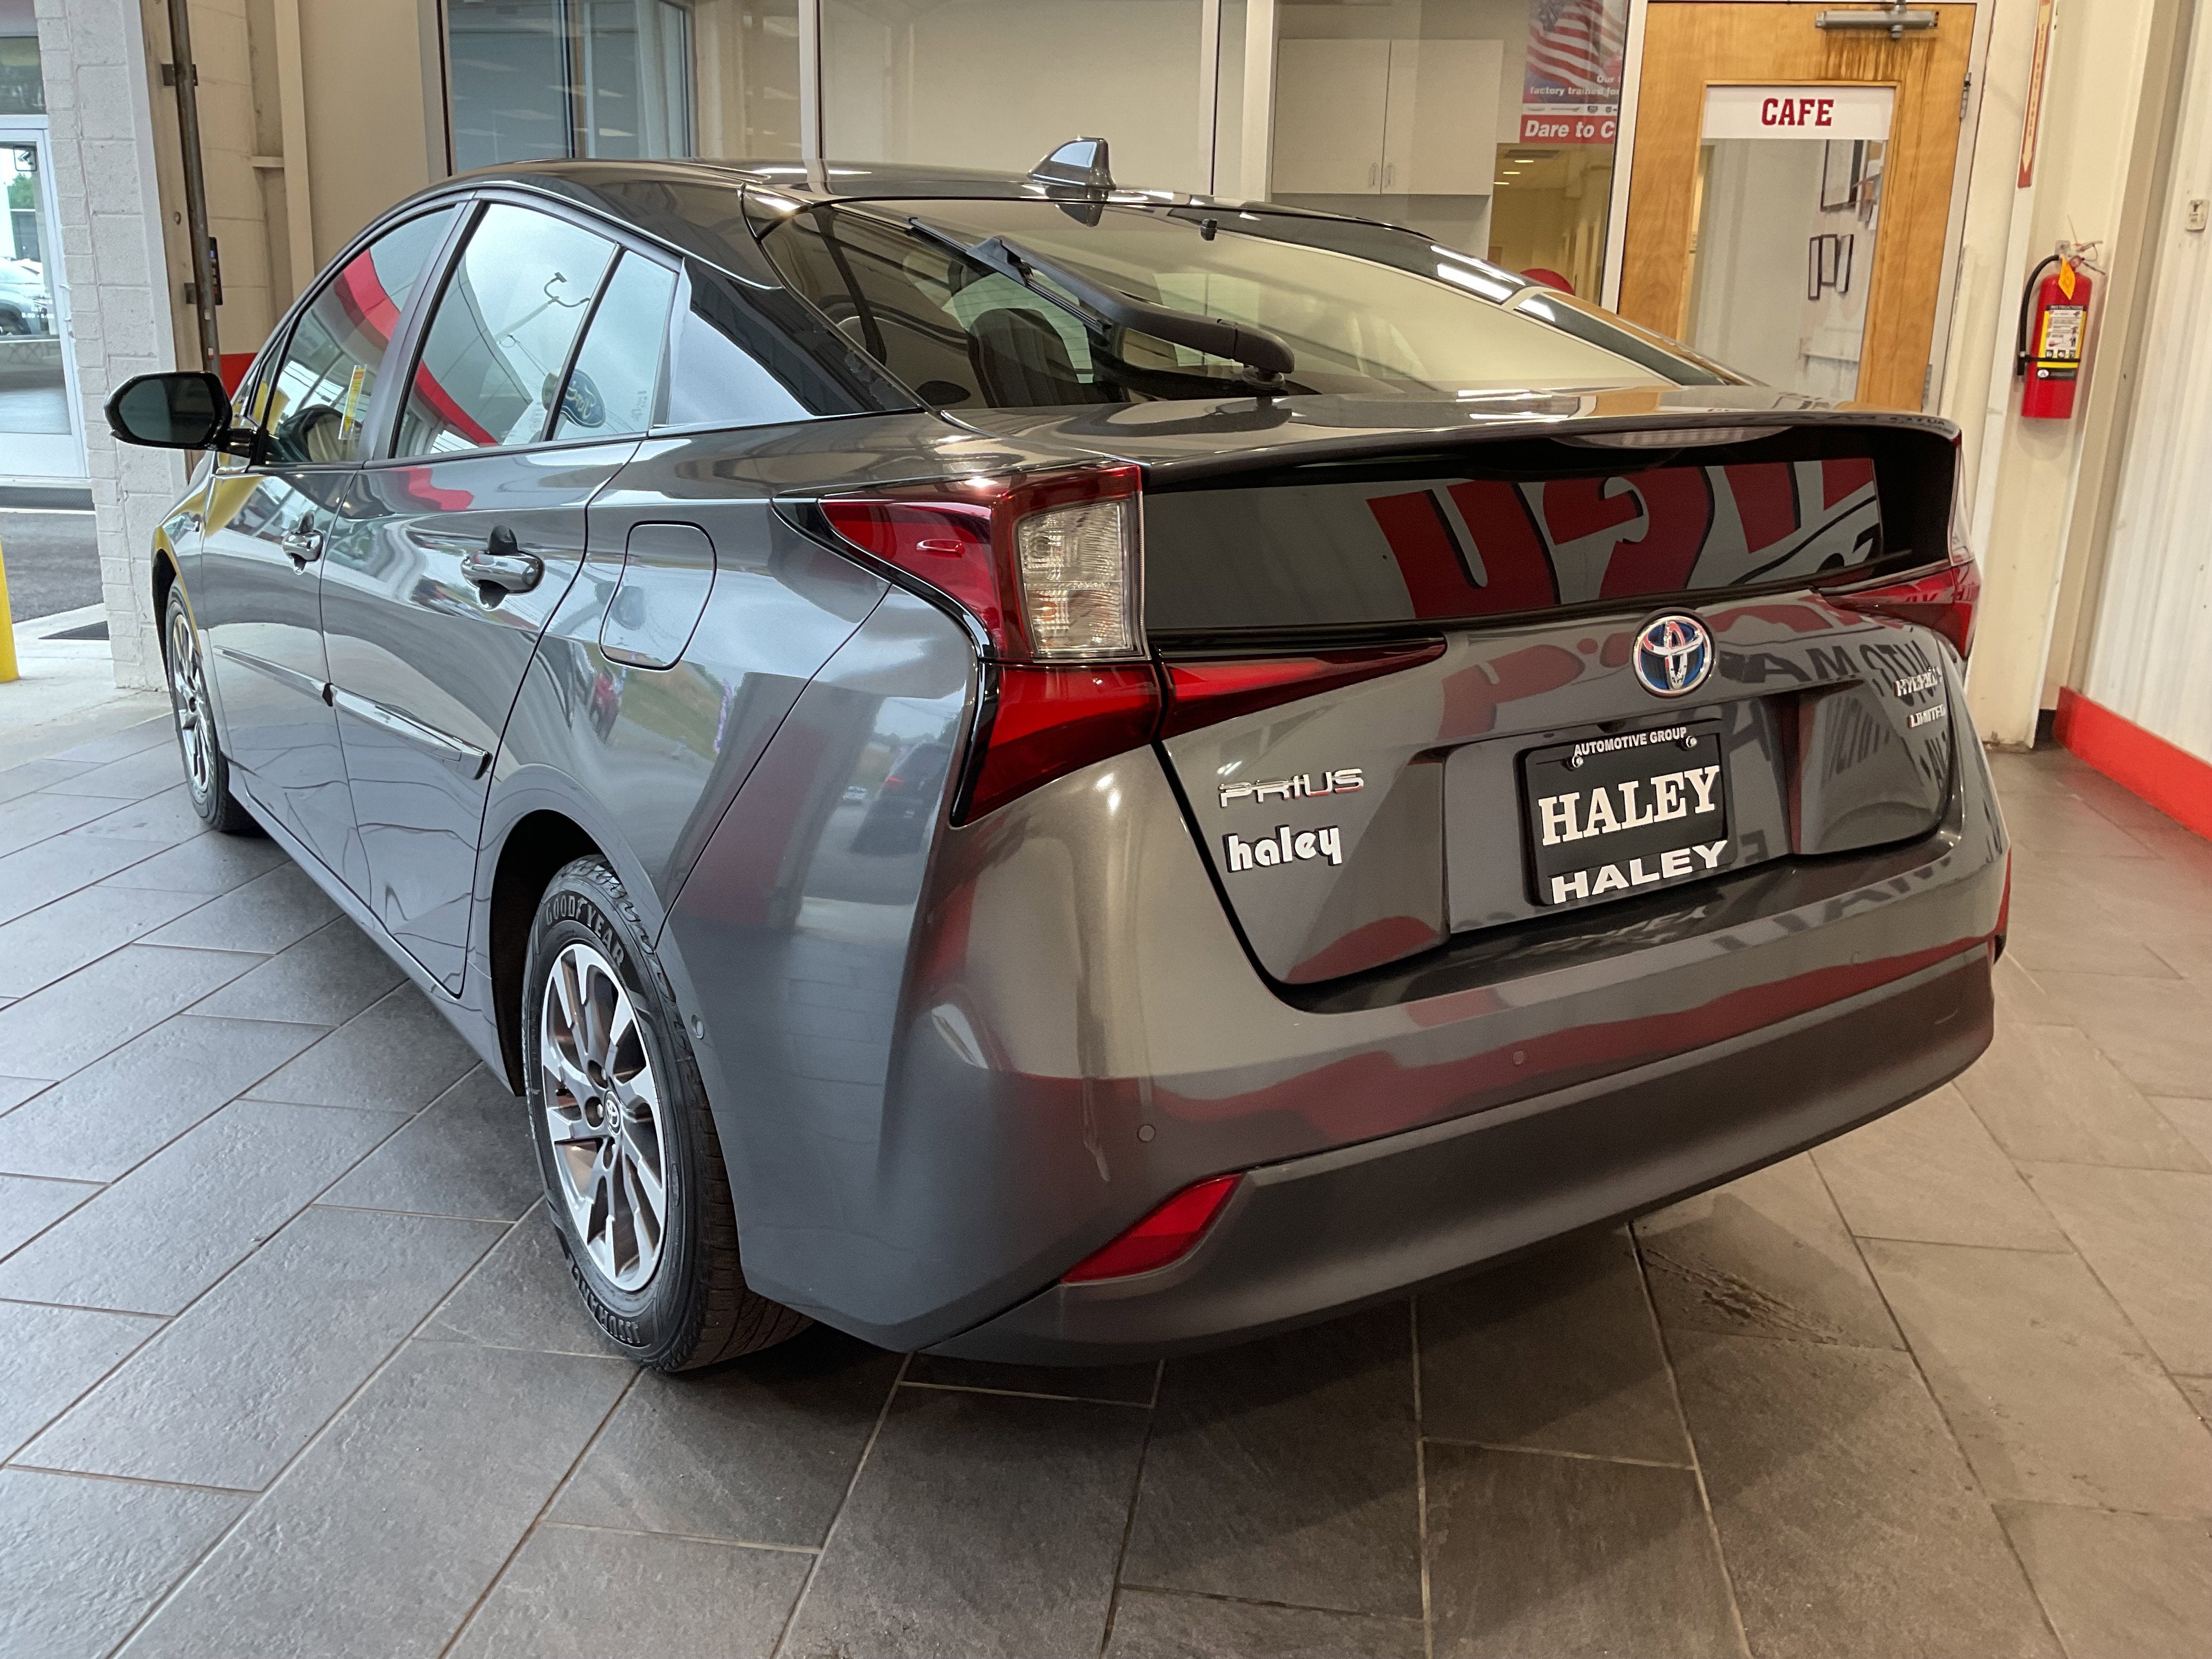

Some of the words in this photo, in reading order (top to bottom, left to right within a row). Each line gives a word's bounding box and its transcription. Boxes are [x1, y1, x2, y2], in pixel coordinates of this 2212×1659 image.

[1530, 87, 1565, 95] factory
[1568, 87, 1603, 95] trained
[1597, 75, 1615, 83] Our
[1762, 98, 1834, 126] CAFE
[1525, 120, 1569, 137] Dare
[1576, 121, 1595, 137] to
[1908, 704, 1946, 728] LIMITED
[1574, 733, 1647, 757] AUTOMOTIVE
[1650, 726, 1687, 746] GROUP
[1219, 768, 1364, 808] PRIUS
[1538, 765, 1720, 846] HALEY
[1224, 825, 1342, 872] haley
[1551, 839, 1728, 904] HALEY
[545, 894, 624, 968] GOODYEAR
